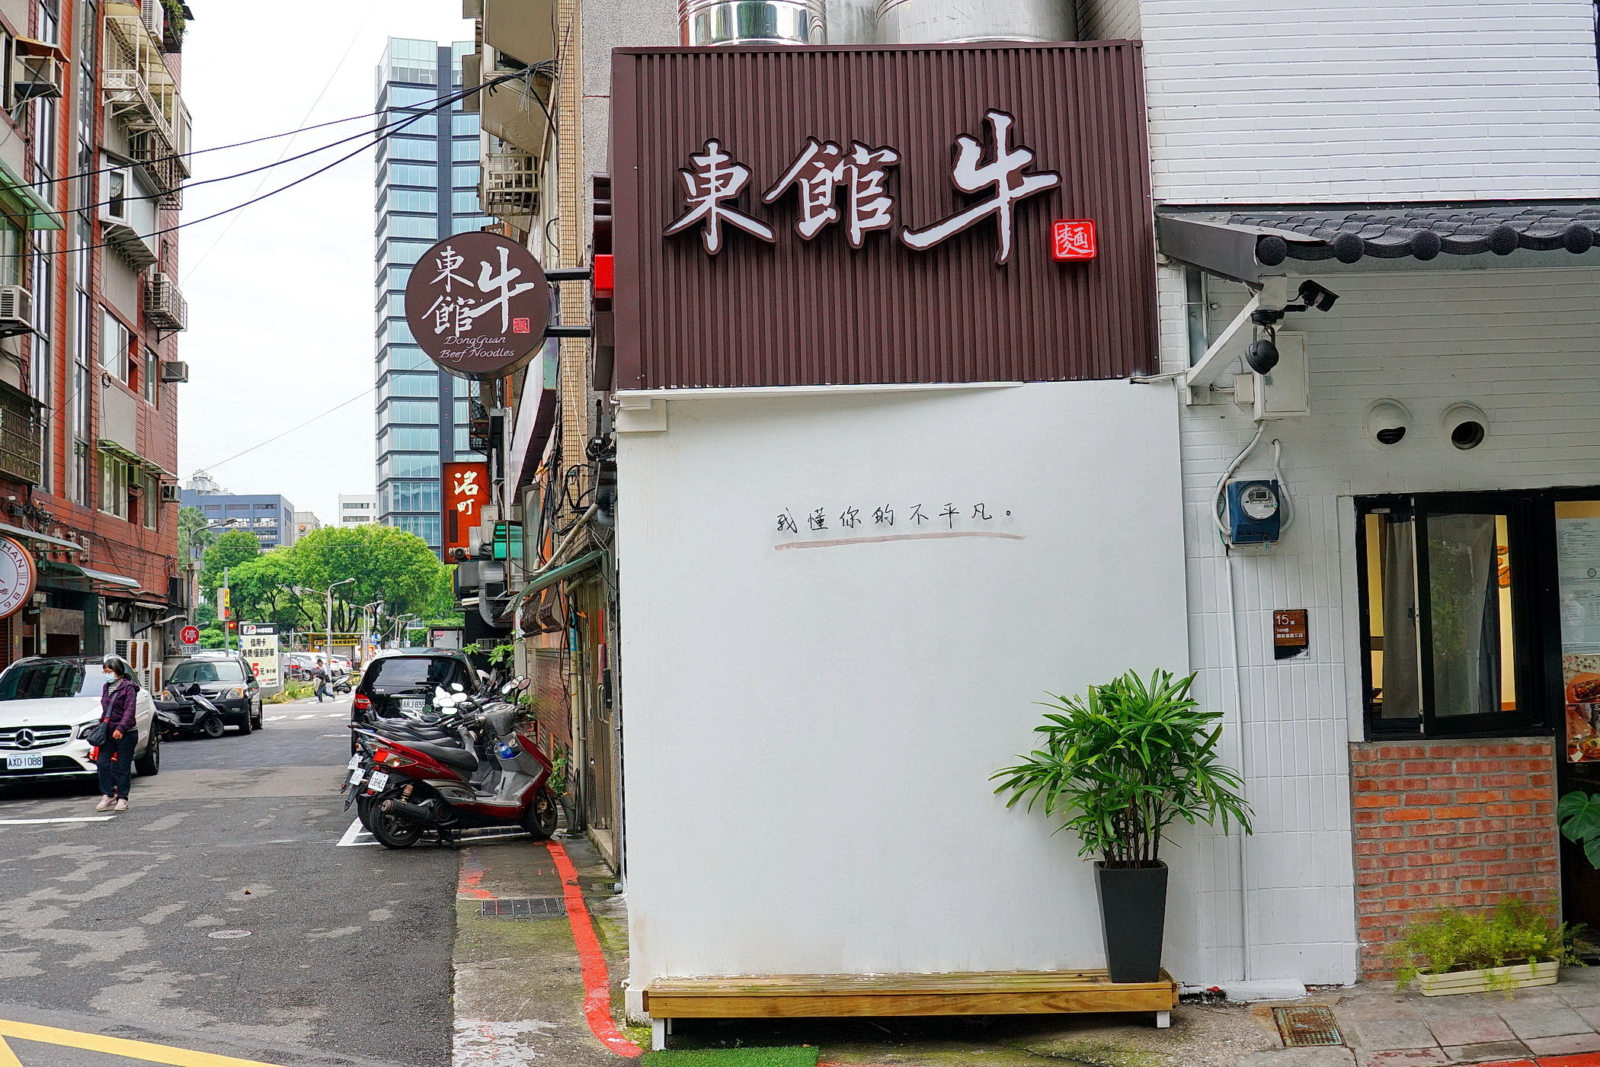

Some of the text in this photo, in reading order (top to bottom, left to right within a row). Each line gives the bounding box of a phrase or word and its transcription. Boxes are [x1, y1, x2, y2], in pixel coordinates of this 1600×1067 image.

[1057, 224, 1093, 255] 麵
[438, 347, 516, 363] Beef Noodles
[184, 629, 197, 641] 停
[182, 646, 199, 654] STOP
